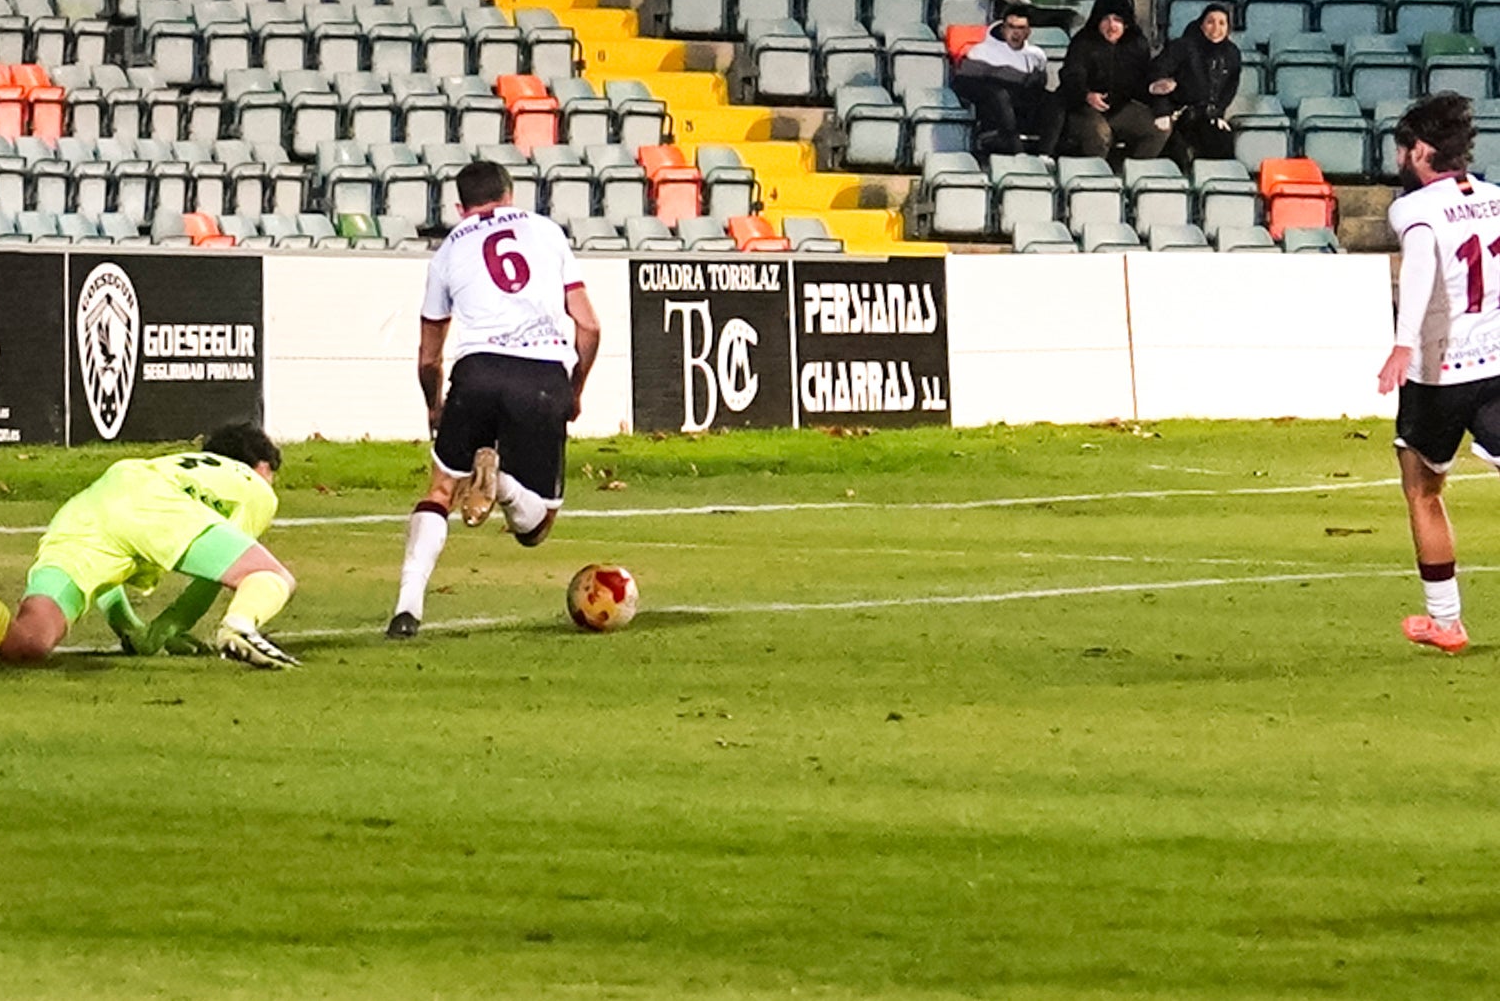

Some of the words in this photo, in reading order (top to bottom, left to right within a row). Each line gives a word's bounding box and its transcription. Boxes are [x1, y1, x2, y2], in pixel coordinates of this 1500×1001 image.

[482, 229, 531, 294] 6
[638, 264, 706, 291] CUADRA
[708, 264, 781, 291] TORBLAZ
[143, 324, 256, 358] GOESEGUR
[143, 362, 205, 381] SEGURIDAD
[207, 362, 255, 380] PRIVADA
[801, 361, 916, 413] CHARRAS
